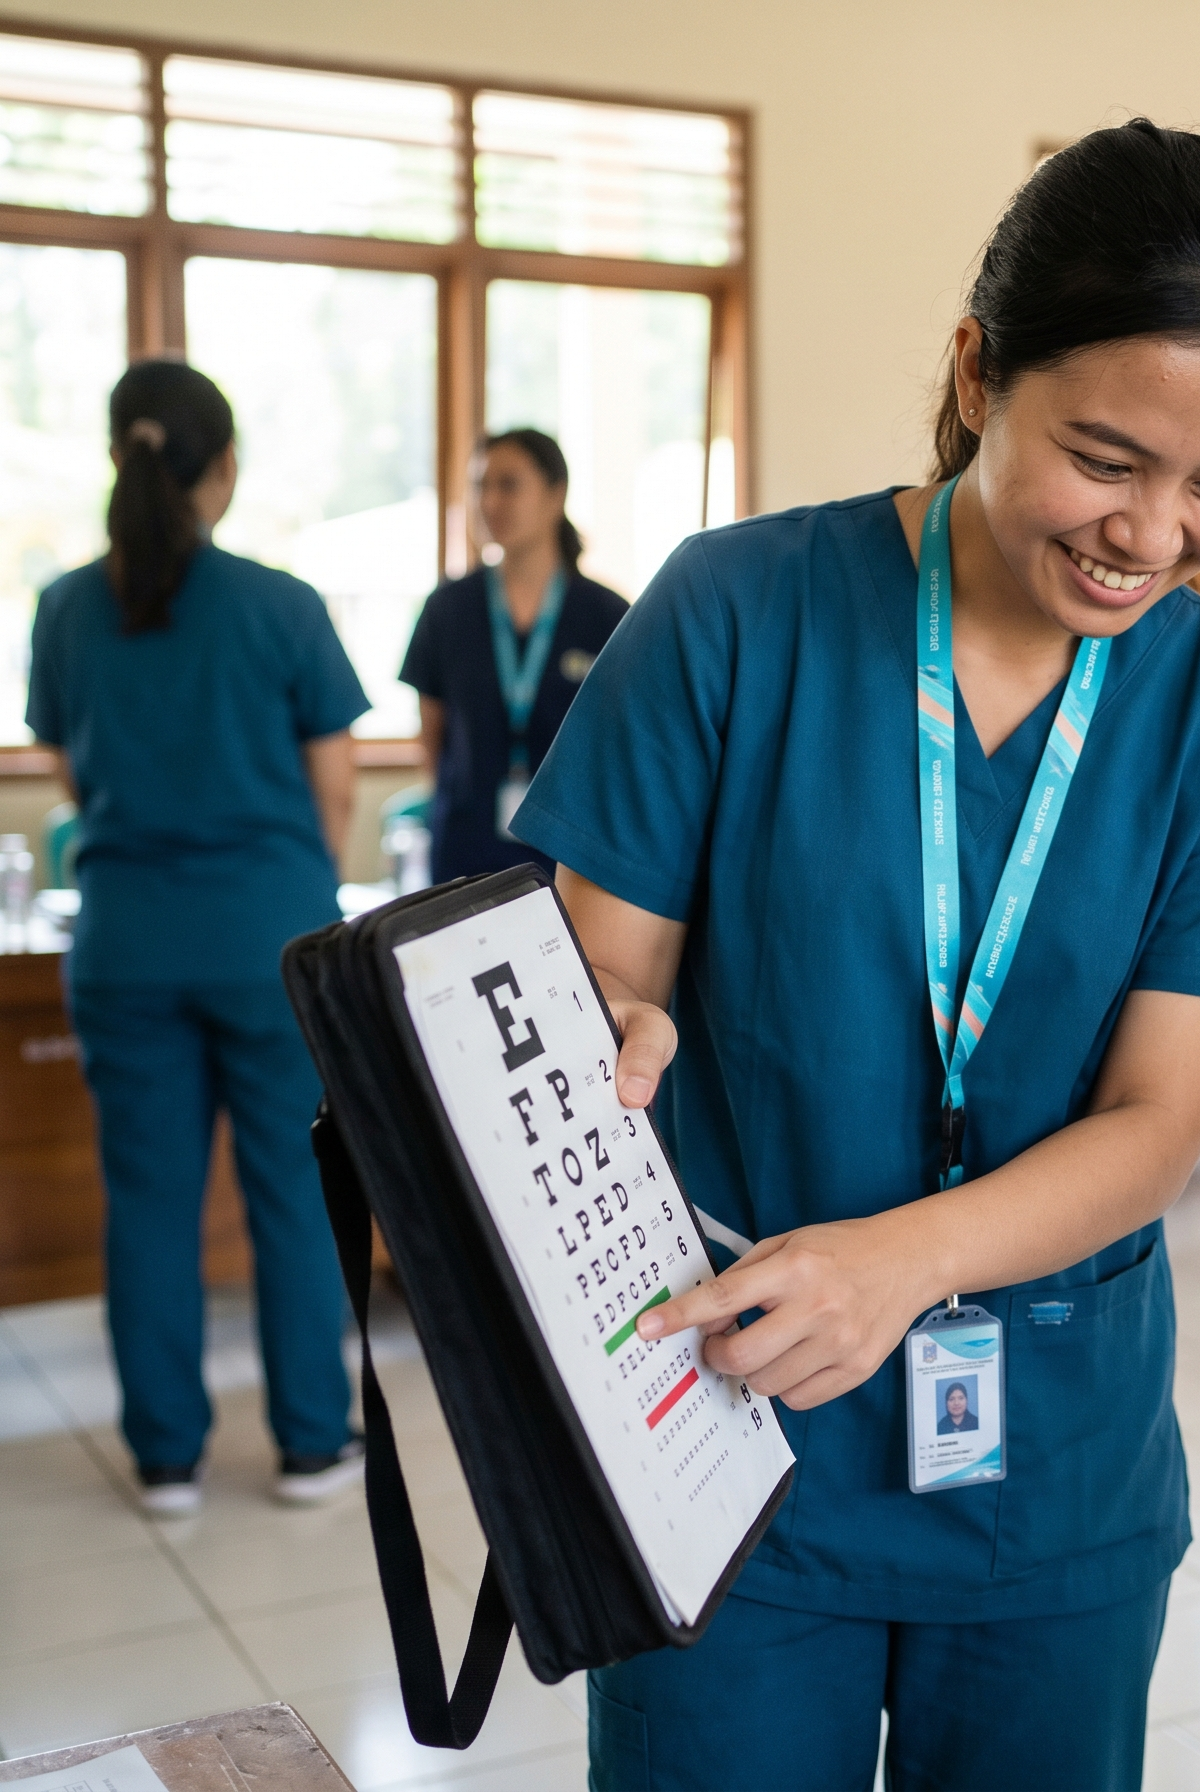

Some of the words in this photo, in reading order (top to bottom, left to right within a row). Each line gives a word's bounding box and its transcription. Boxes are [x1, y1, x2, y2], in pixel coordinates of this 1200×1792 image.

[471, 961, 546, 1073] E
[572, 990, 583, 1012] 1
[598, 1059, 612, 1083] 2
[623, 1115, 636, 1138] 3
[557, 1181, 629, 1257] LPED
[646, 1160, 657, 1182] 4
[576, 1224, 647, 1299] PECFD
[661, 1200, 673, 1222] 5
[676, 1235, 688, 1257] 6
